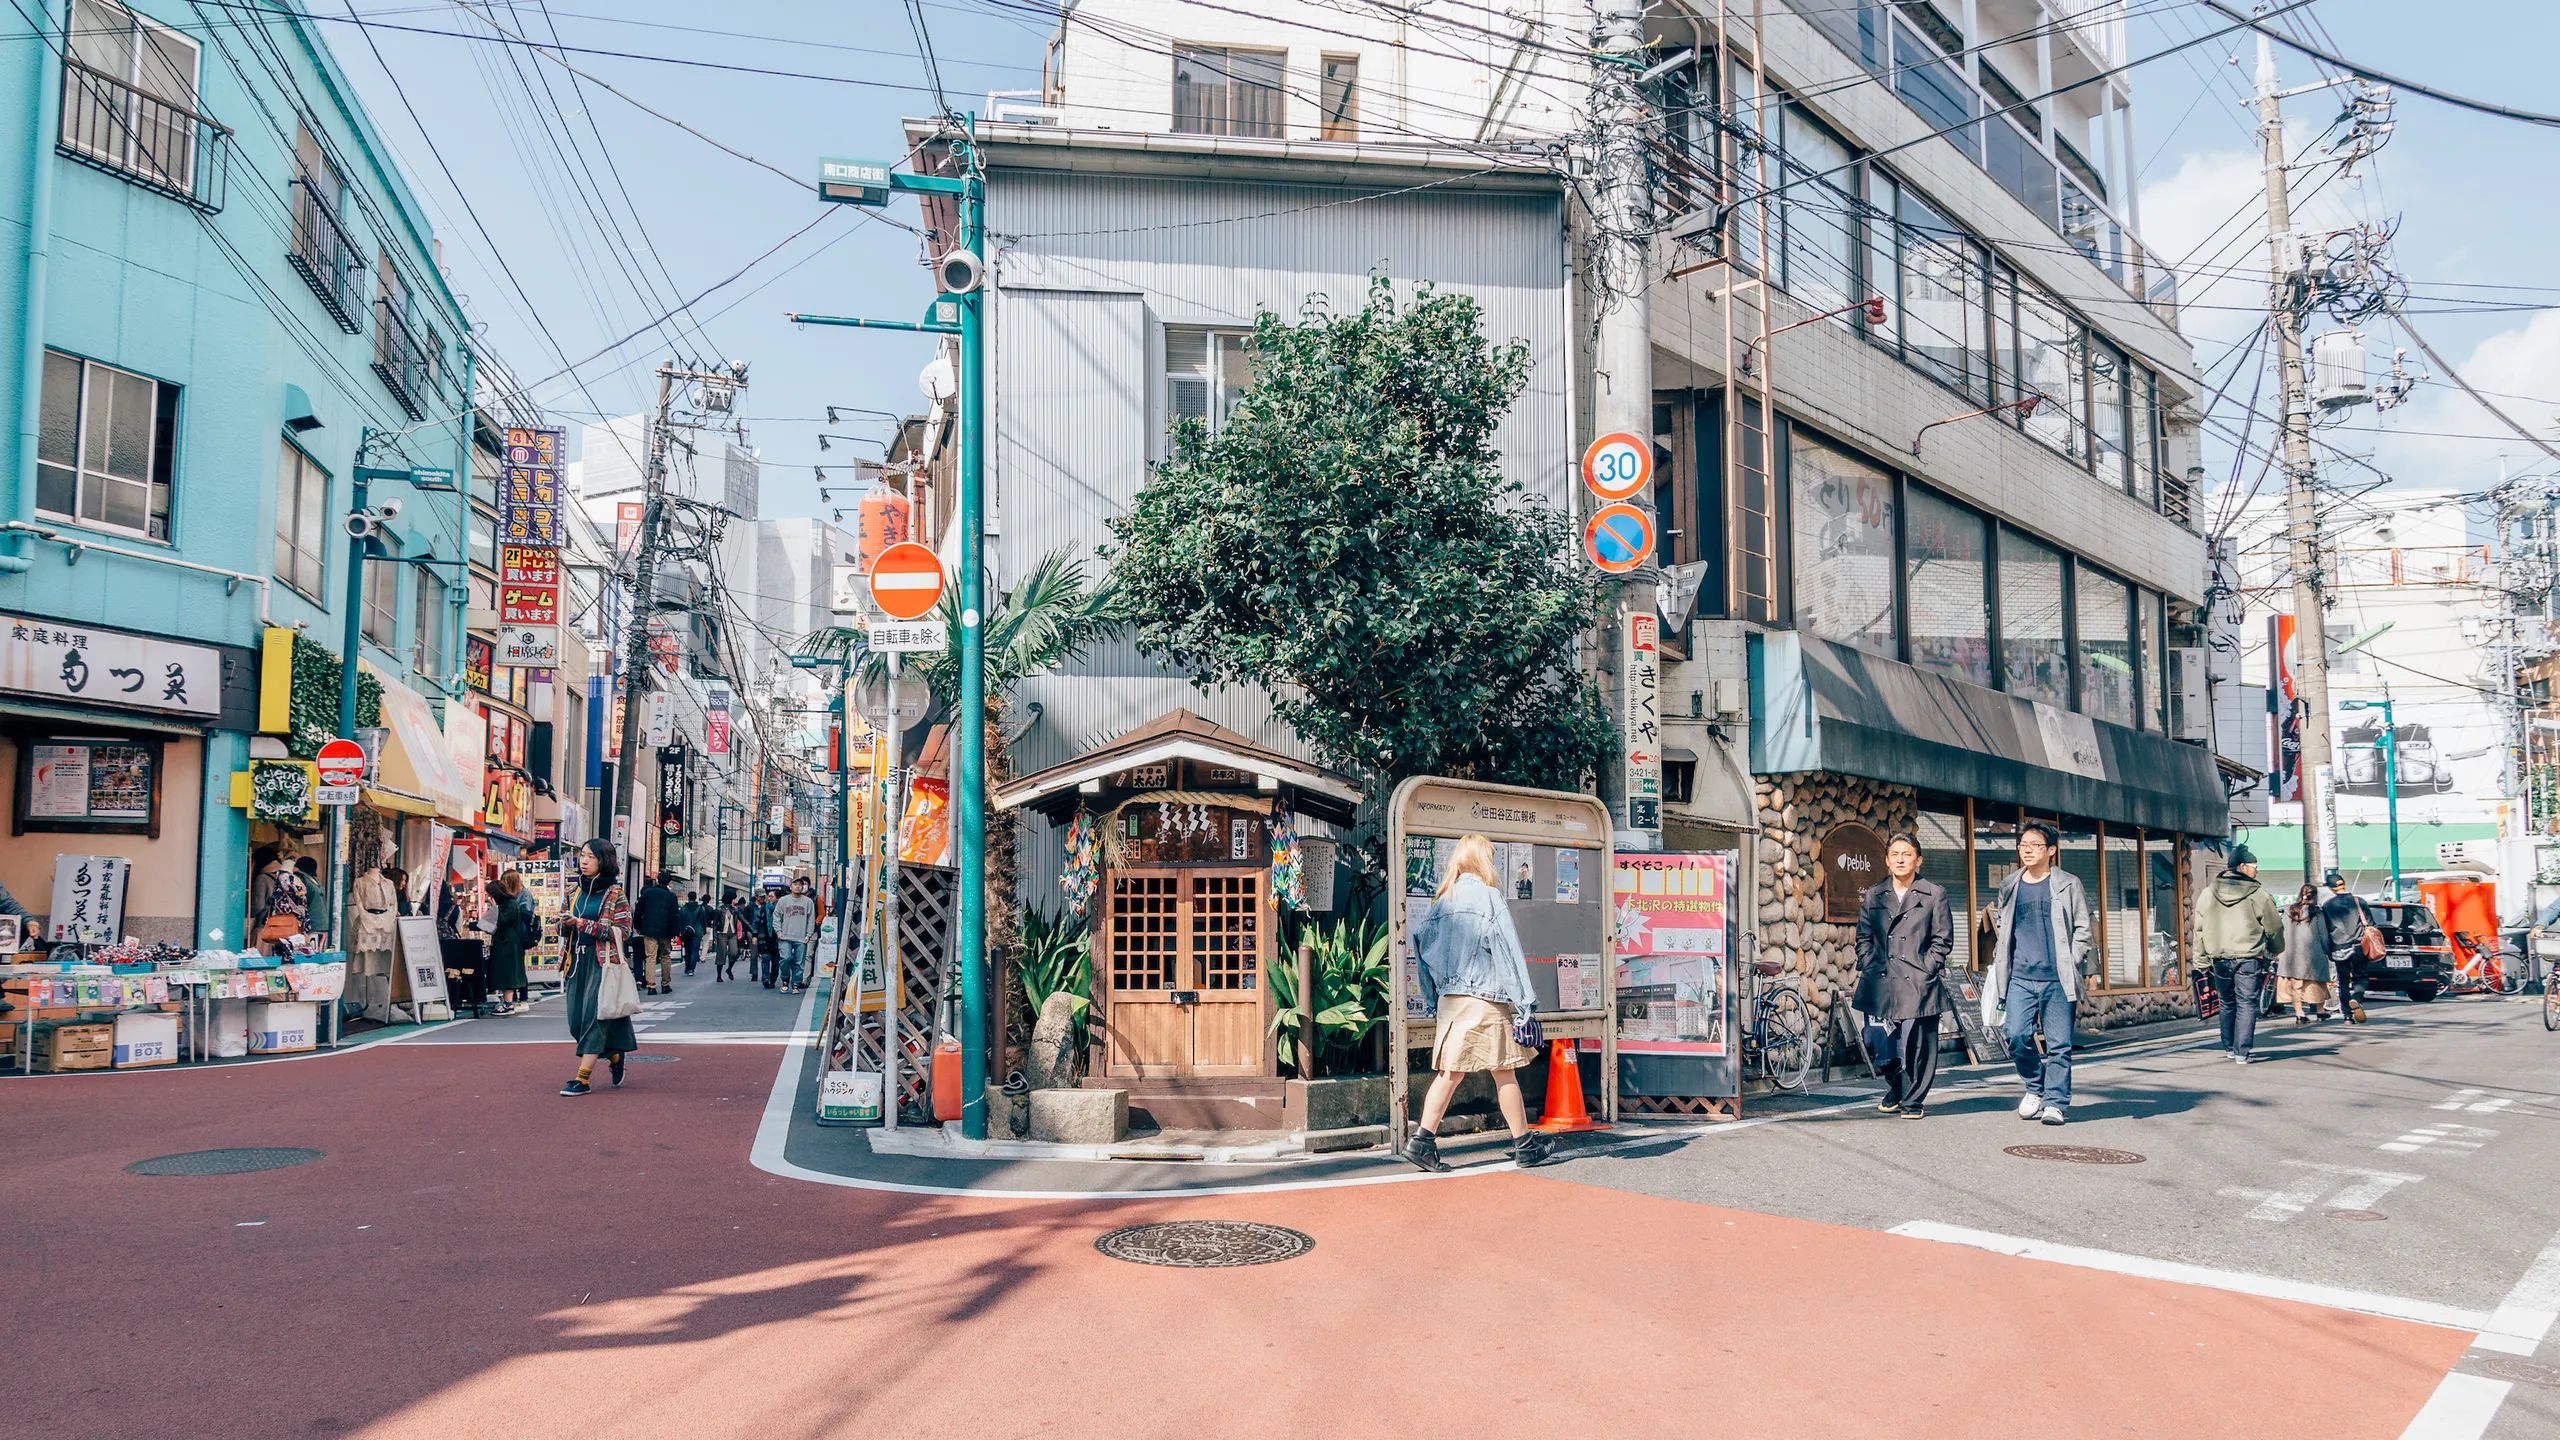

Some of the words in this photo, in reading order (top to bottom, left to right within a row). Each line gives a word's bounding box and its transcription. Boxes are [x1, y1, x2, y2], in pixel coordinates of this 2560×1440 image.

[824, 163, 884, 180] 南口商店街
[413, 469, 450, 478] shimokita
[1600, 452, 1636, 482] 30
[506, 549, 520, 560] 2F
[506, 568, 555, 583] 買います
[506, 590, 554, 606] ゲーム
[505, 607, 554, 622] 買います
[11, 624, 89, 650] 家庭料理
[873, 629, 941, 645] 自転車を除く
[466, 669, 485, 687] トレカ
[1417, 802, 1456, 813] INFORMATION
[1481, 806, 1537, 824] 世田谷区広報板
[1847, 854, 1871, 872] pebble
[1625, 899, 1725, 913] 下北沢の特選物件
[135, 1048, 163, 1057] BOX
